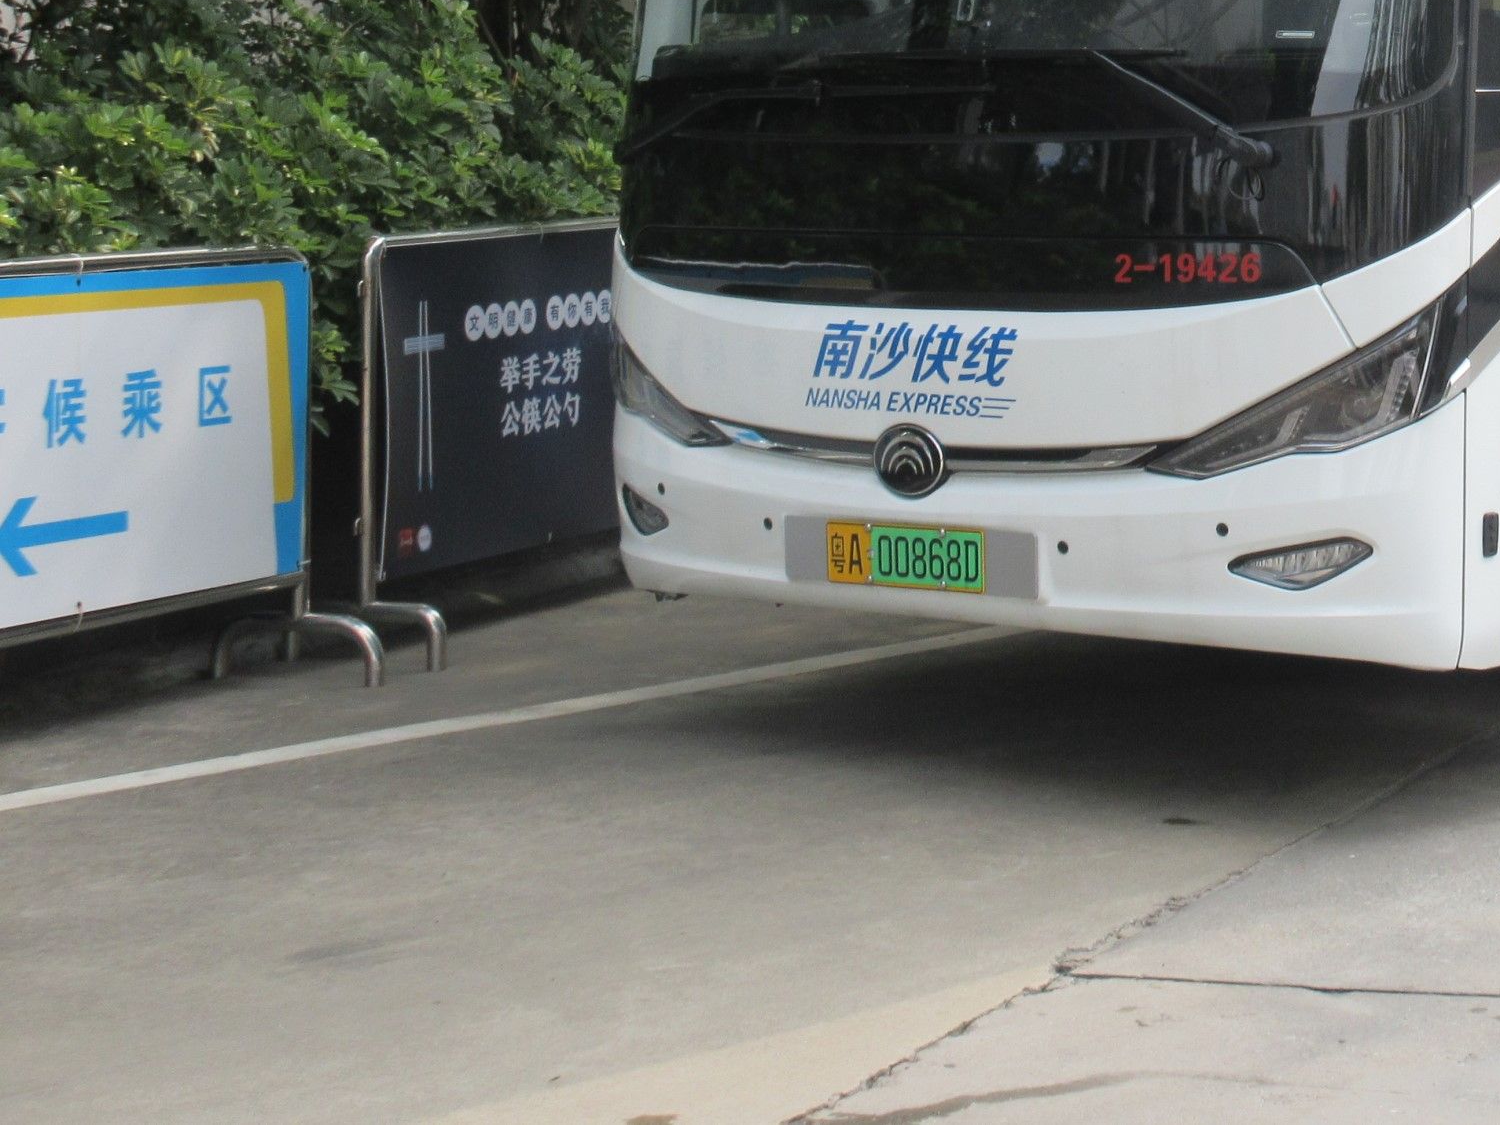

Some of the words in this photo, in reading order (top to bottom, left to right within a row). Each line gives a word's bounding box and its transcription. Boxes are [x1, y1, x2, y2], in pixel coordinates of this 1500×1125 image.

[1114, 253, 1263, 284] 2-19426
[468, 305, 535, 334] 文明健康
[500, 346, 582, 393] 举手之劳
[813, 320, 1018, 387] 南沙快线
[0, 364, 232, 449] 候乘区
[500, 391, 580, 437] 公筷公勺
[805, 387, 881, 410] NANSHA
[886, 391, 982, 417] EXPRESS
